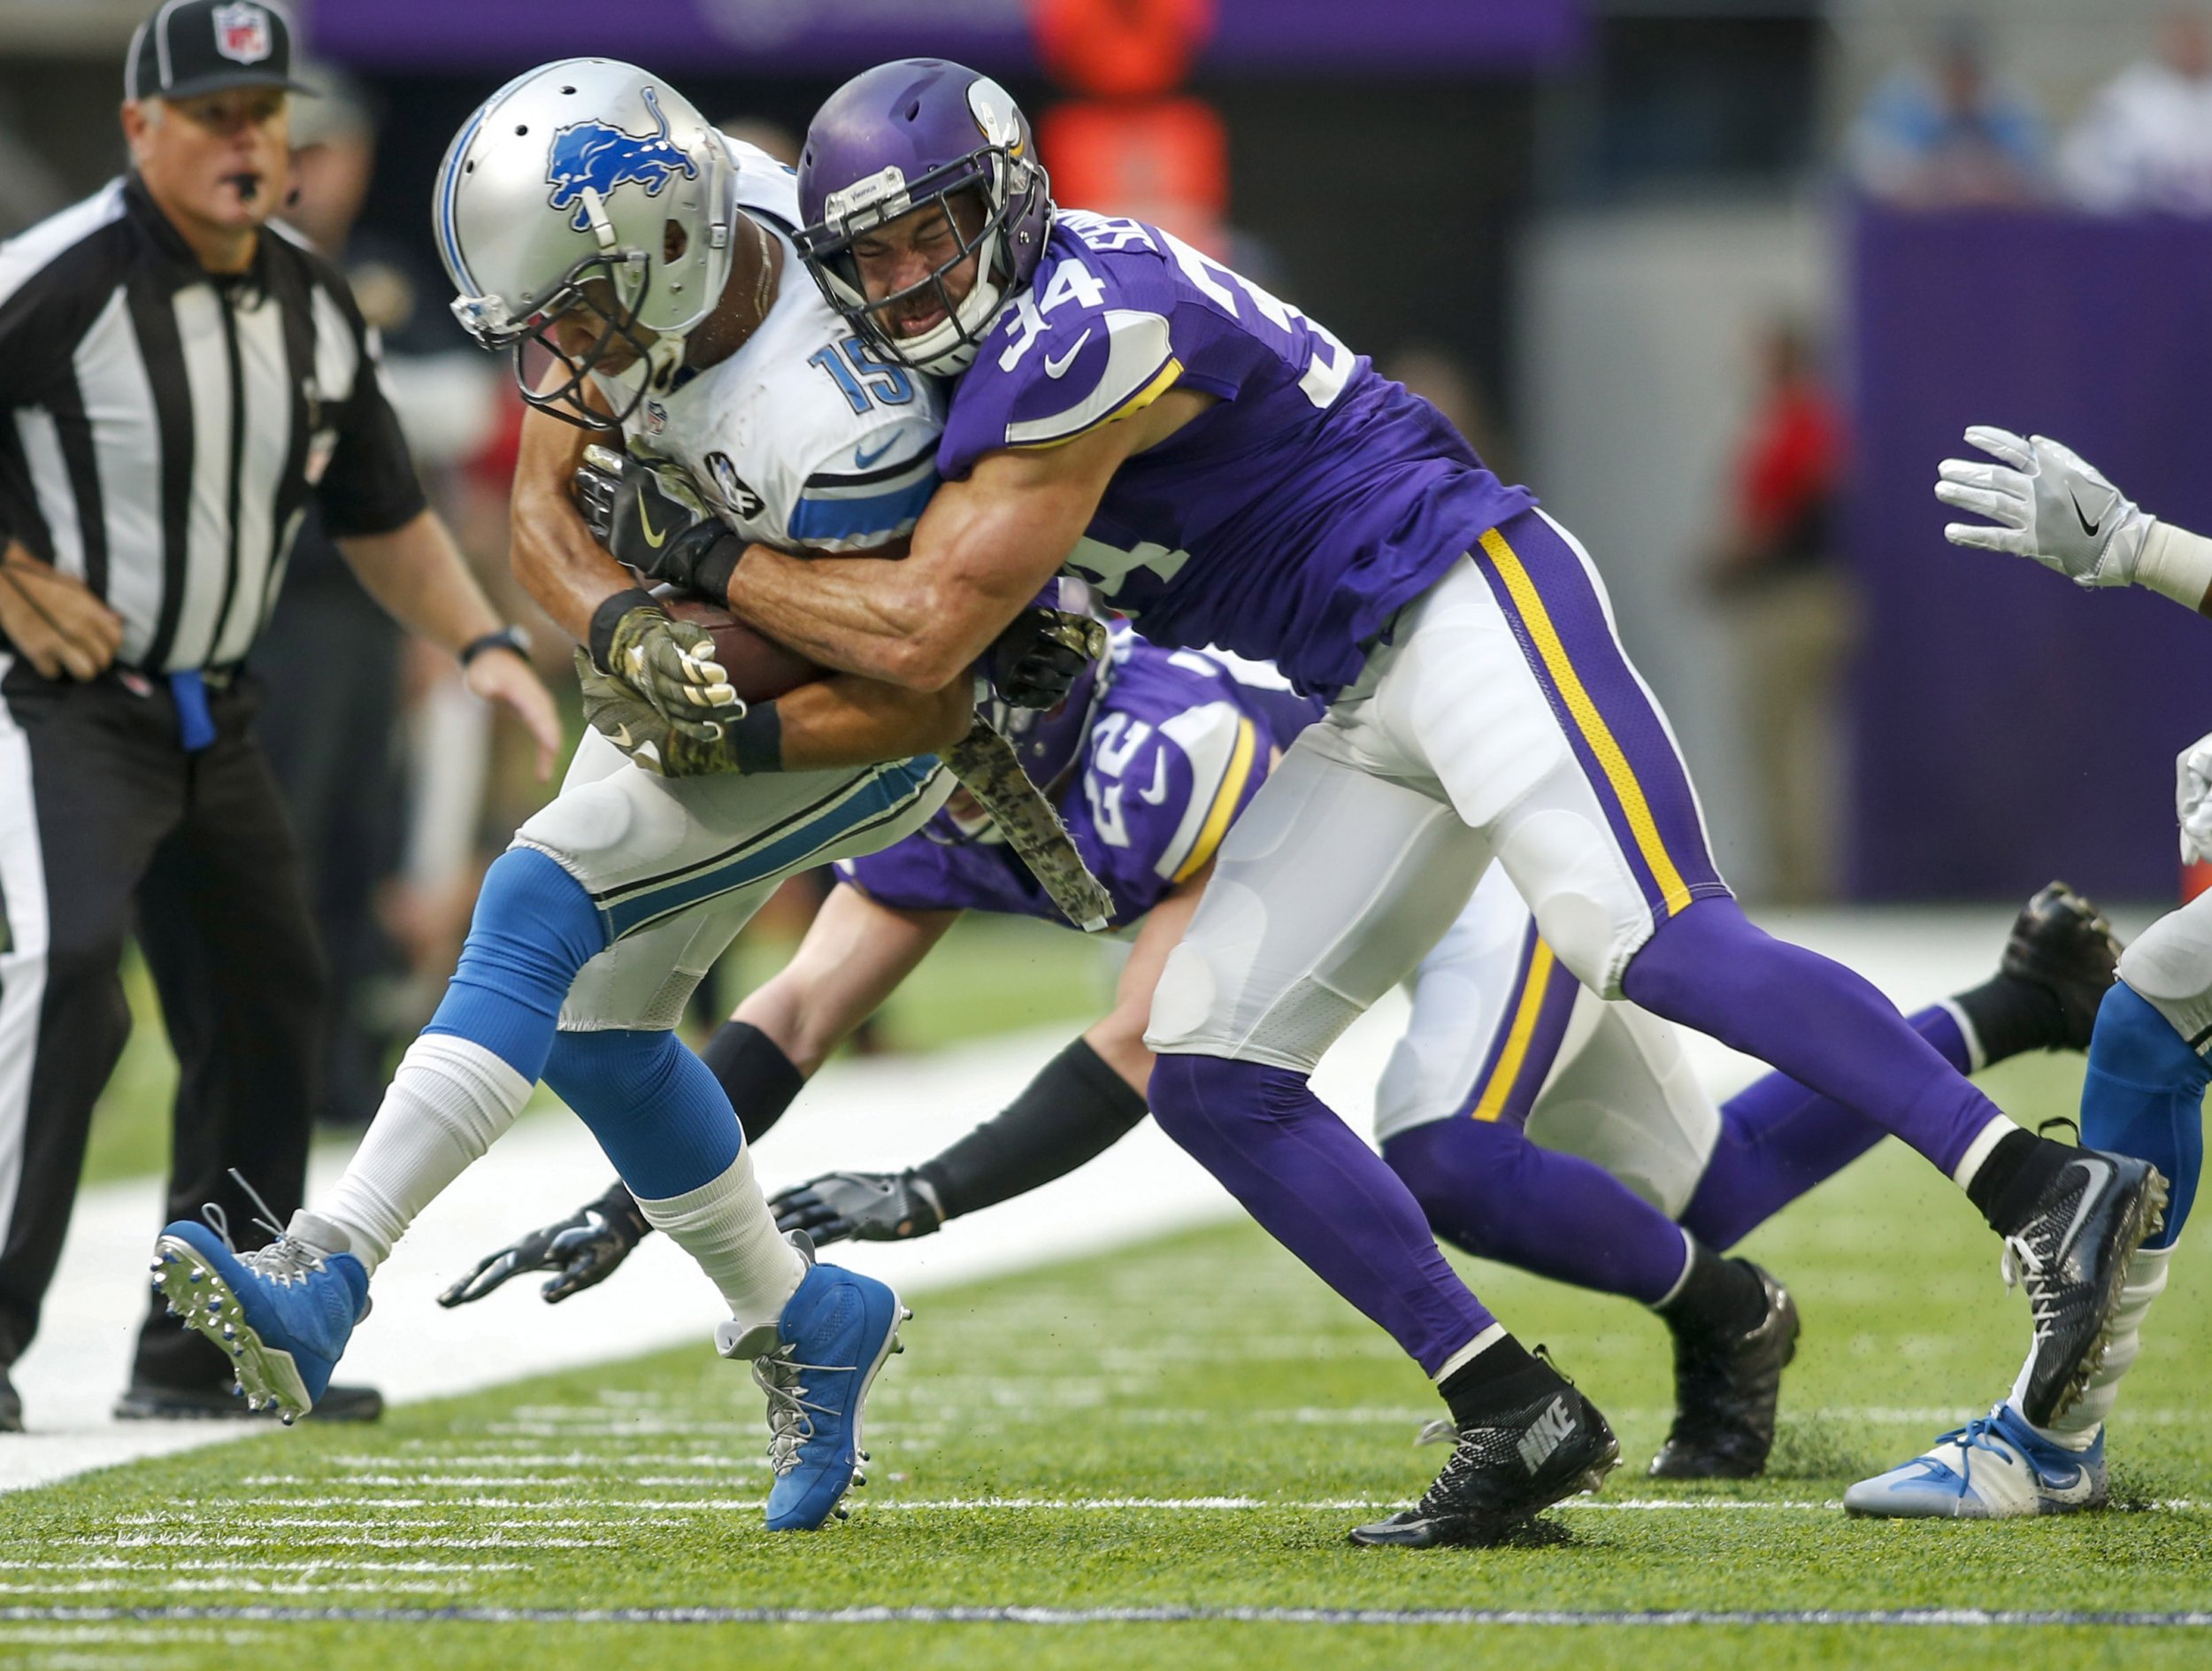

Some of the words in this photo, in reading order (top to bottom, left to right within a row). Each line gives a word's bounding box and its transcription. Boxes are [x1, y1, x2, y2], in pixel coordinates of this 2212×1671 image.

[997, 258, 1107, 373] 34
[807, 335, 915, 416] 15
[1083, 711, 1153, 850] 22
[1516, 1395, 1577, 1476] NIKE
